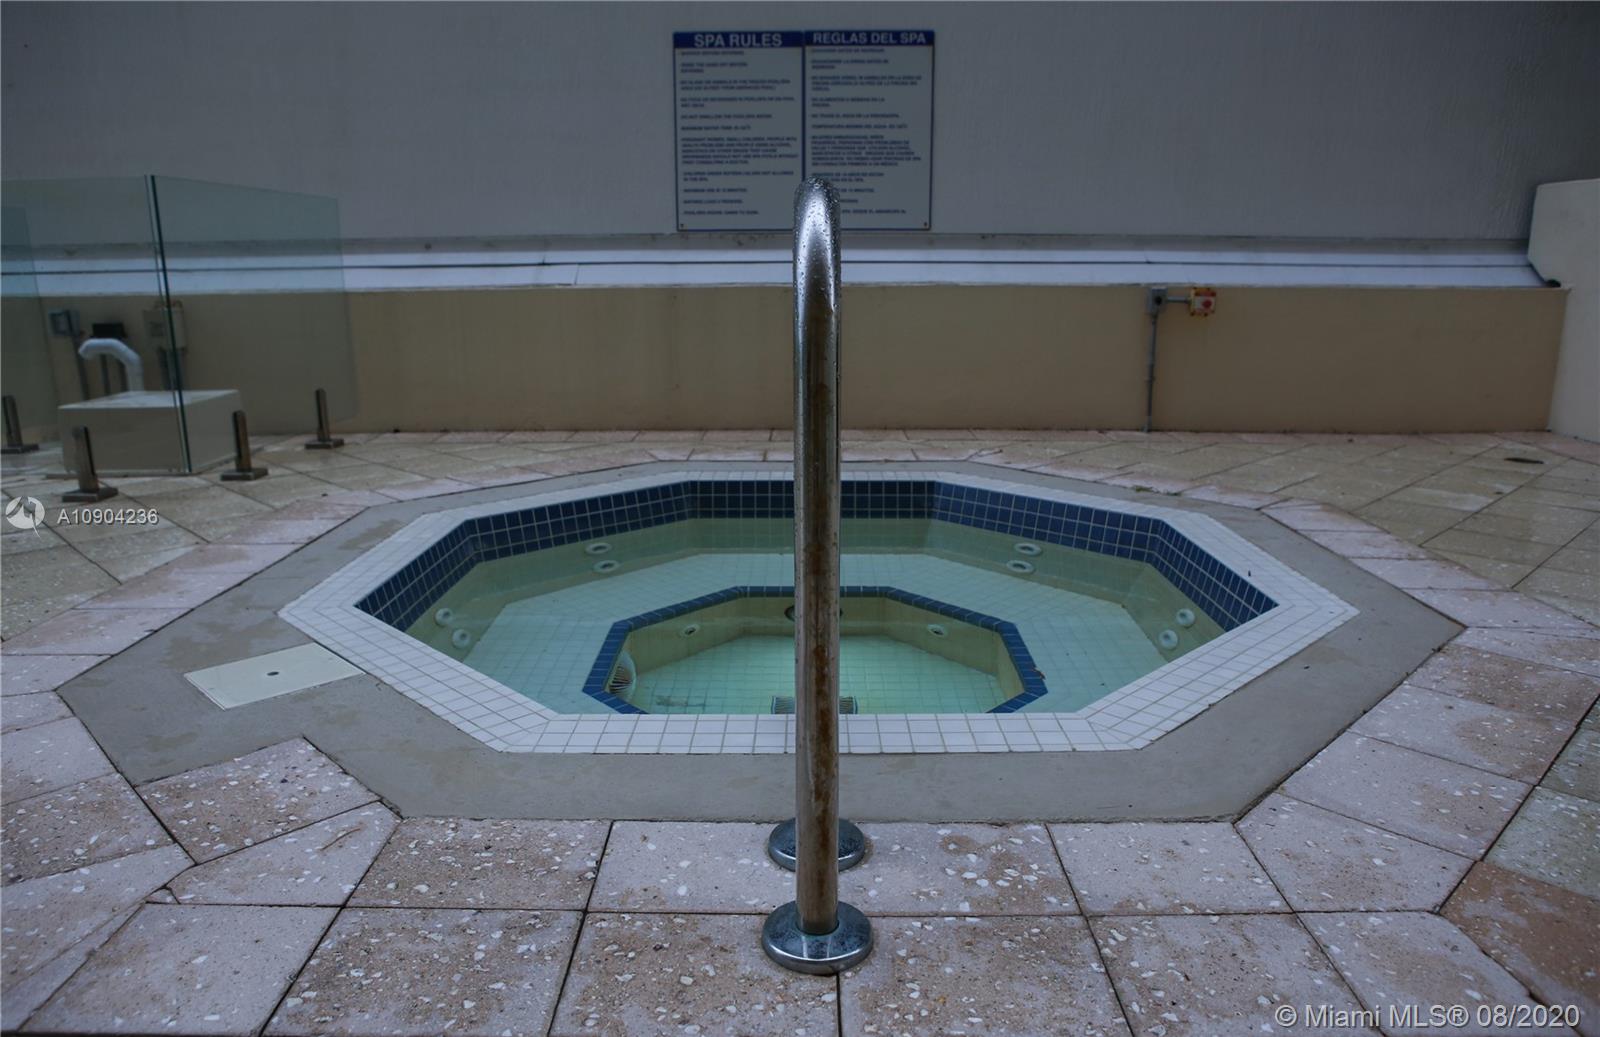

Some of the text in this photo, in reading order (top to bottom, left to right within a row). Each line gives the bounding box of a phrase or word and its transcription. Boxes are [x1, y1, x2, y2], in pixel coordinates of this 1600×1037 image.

[694, 33, 783, 46] SPA RULES
[813, 32, 927, 44] REGLAS DEL SPA
